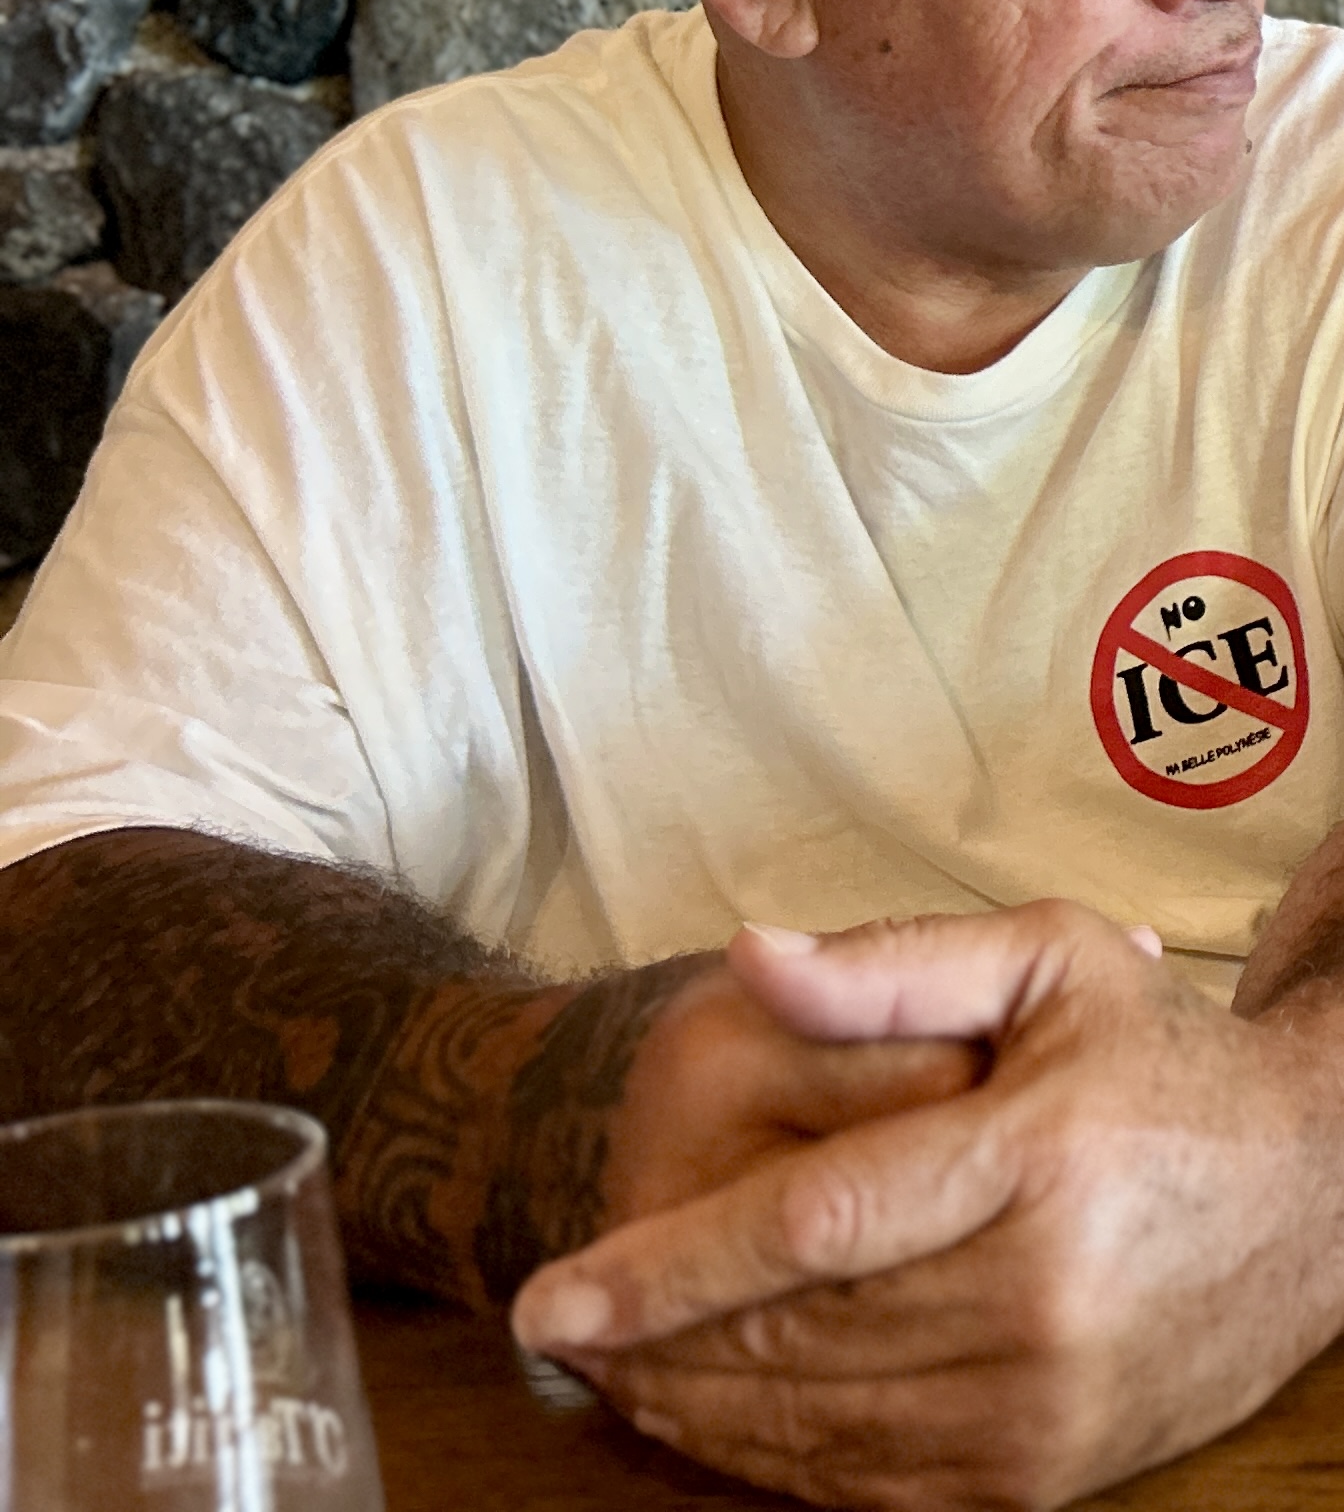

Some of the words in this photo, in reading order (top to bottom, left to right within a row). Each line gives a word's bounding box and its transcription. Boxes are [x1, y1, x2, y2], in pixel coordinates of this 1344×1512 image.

[1160, 595, 1206, 642] NO
[1116, 616, 1289, 745] ICE
[1165, 763, 1181, 777] MA
[1182, 749, 1216, 774] BELLE
[1216, 727, 1272, 759] POLYNÉSIE
